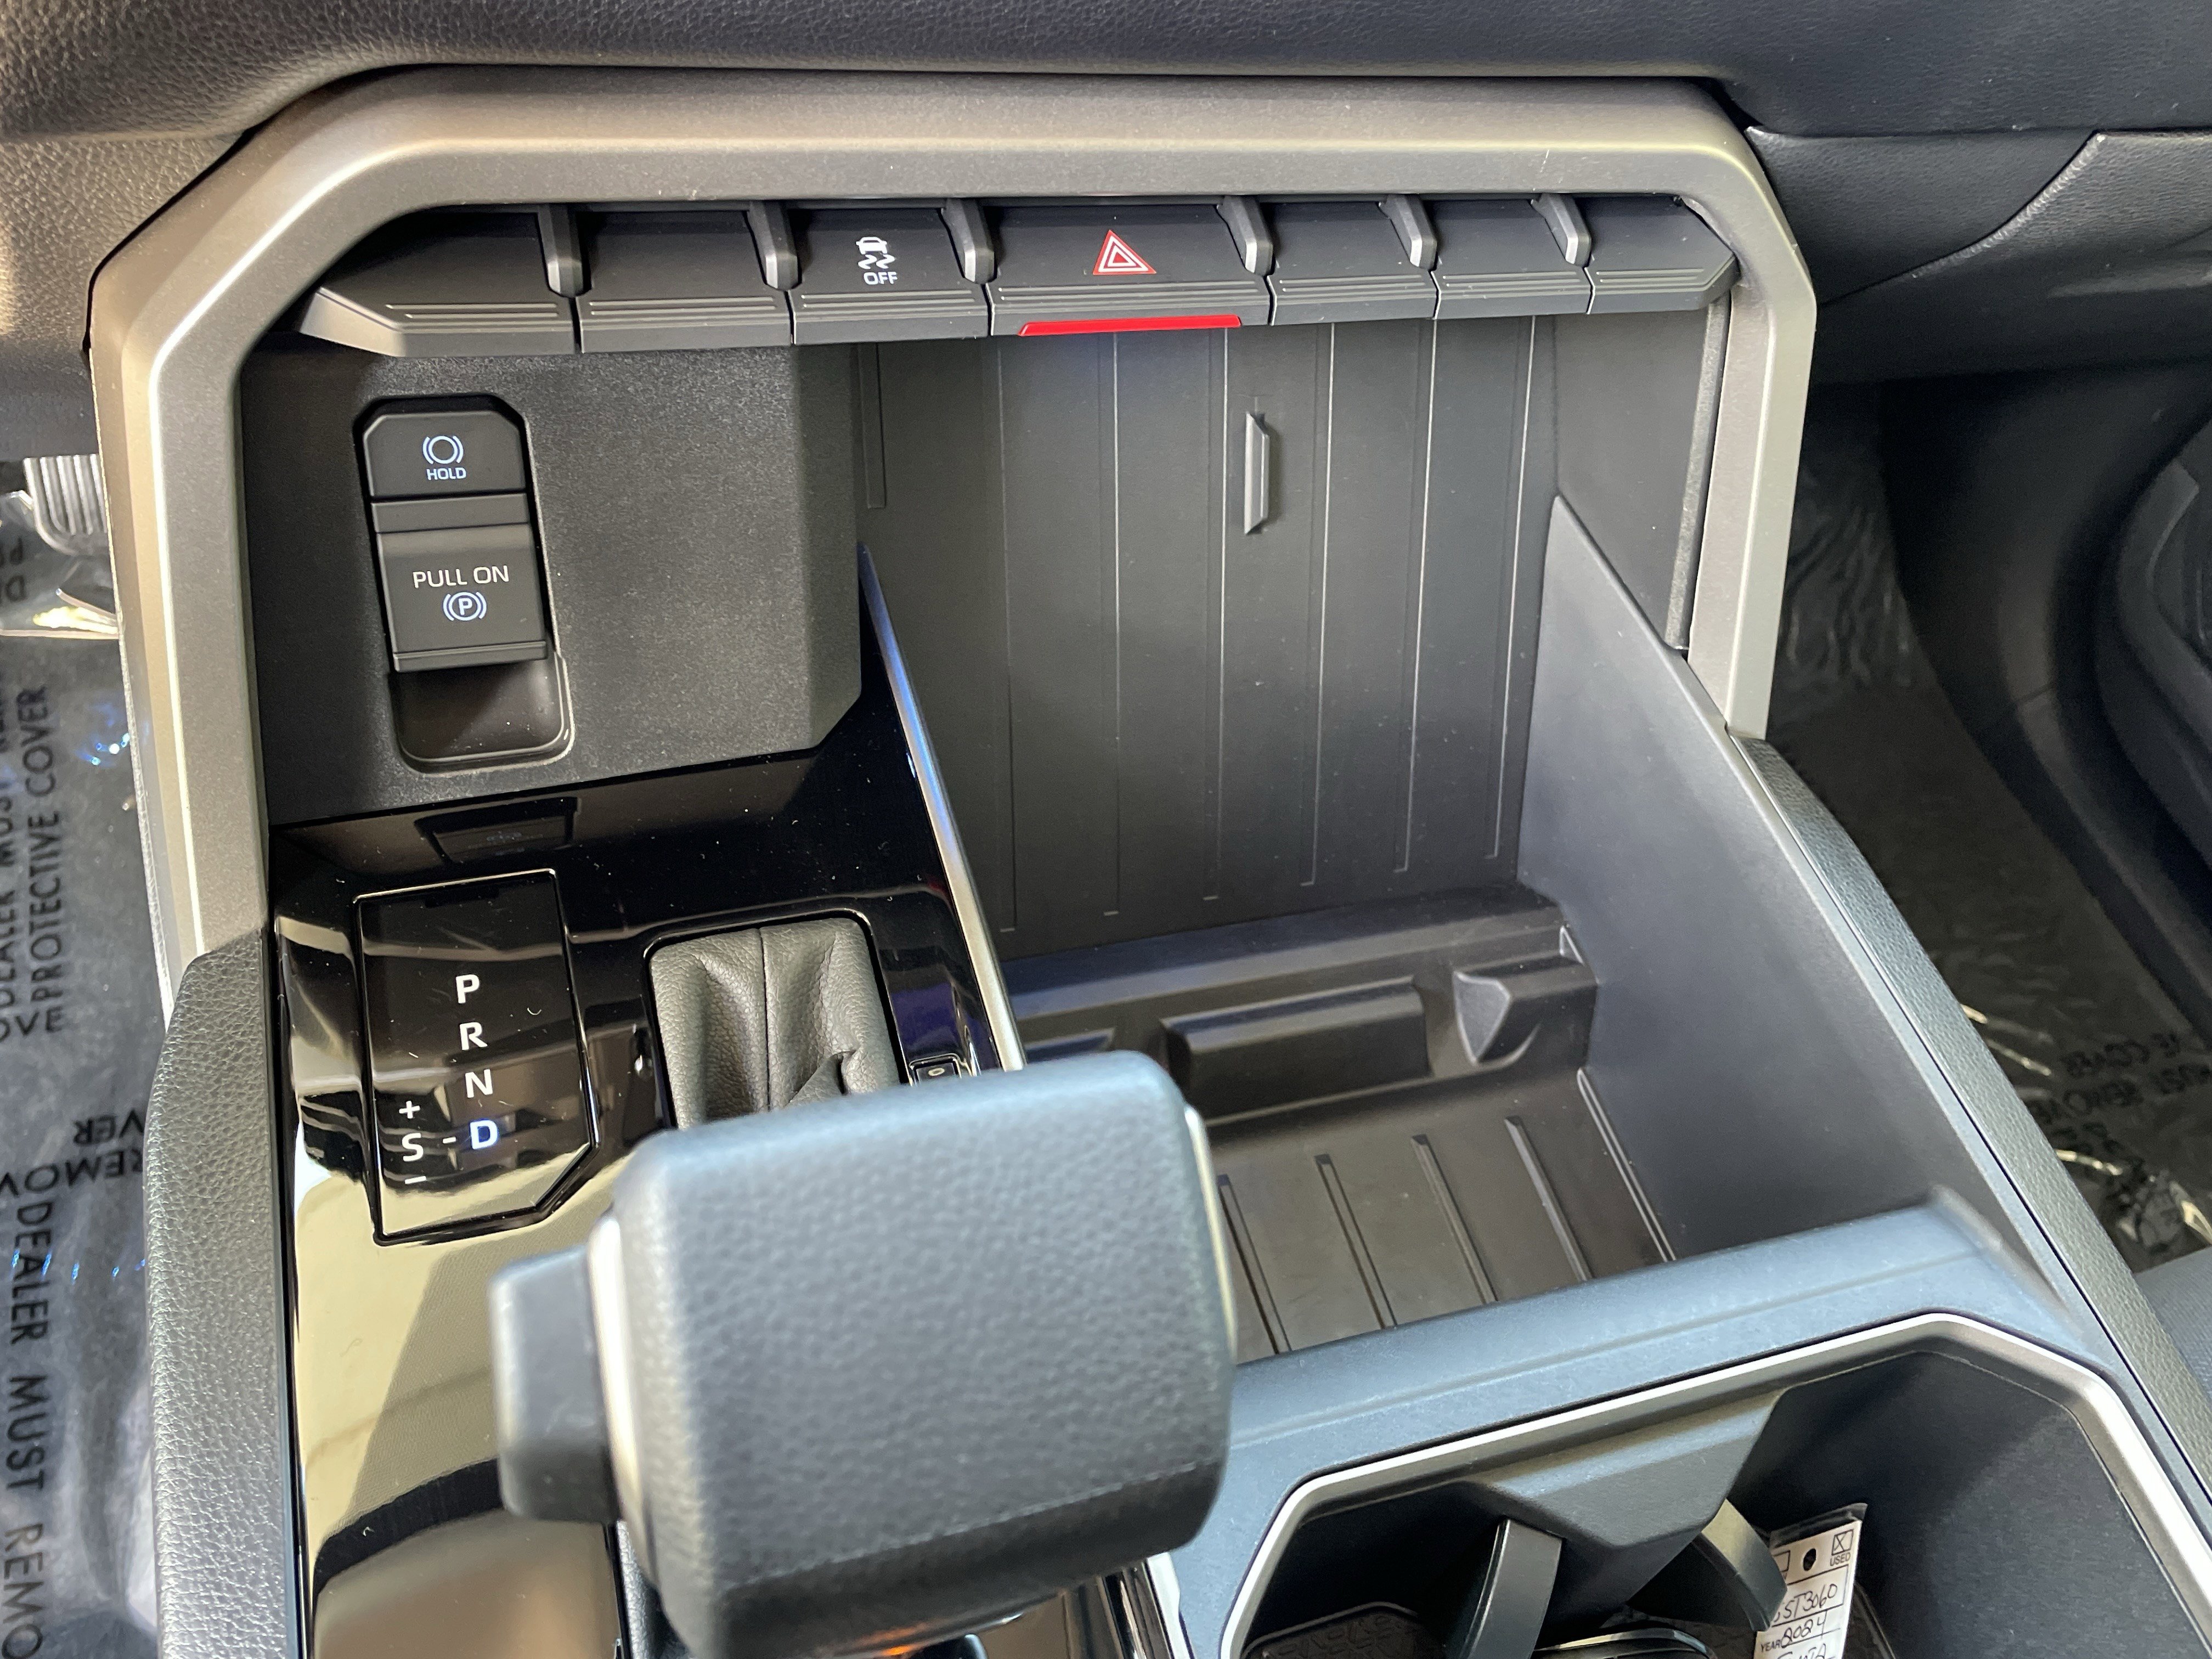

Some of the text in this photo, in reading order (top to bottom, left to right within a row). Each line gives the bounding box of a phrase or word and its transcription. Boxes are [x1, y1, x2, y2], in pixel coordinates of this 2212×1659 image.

[863, 271, 898, 285] OFF
[426, 467, 467, 481] HOLD
[413, 565, 509, 589] PULL ON
[16, 685, 62, 1002] PROTECTIVE COVER
[455, 974, 480, 1003] P
[459, 1022, 488, 1050] R
[465, 1069, 493, 1098] N
[402, 1133, 424, 1162] S
[469, 1119, 499, 1150] D
[10, 1202, 52, 1345] DEALER
[5, 1374, 49, 1492] MUST
[1830, 1551, 1851, 1566] USED
